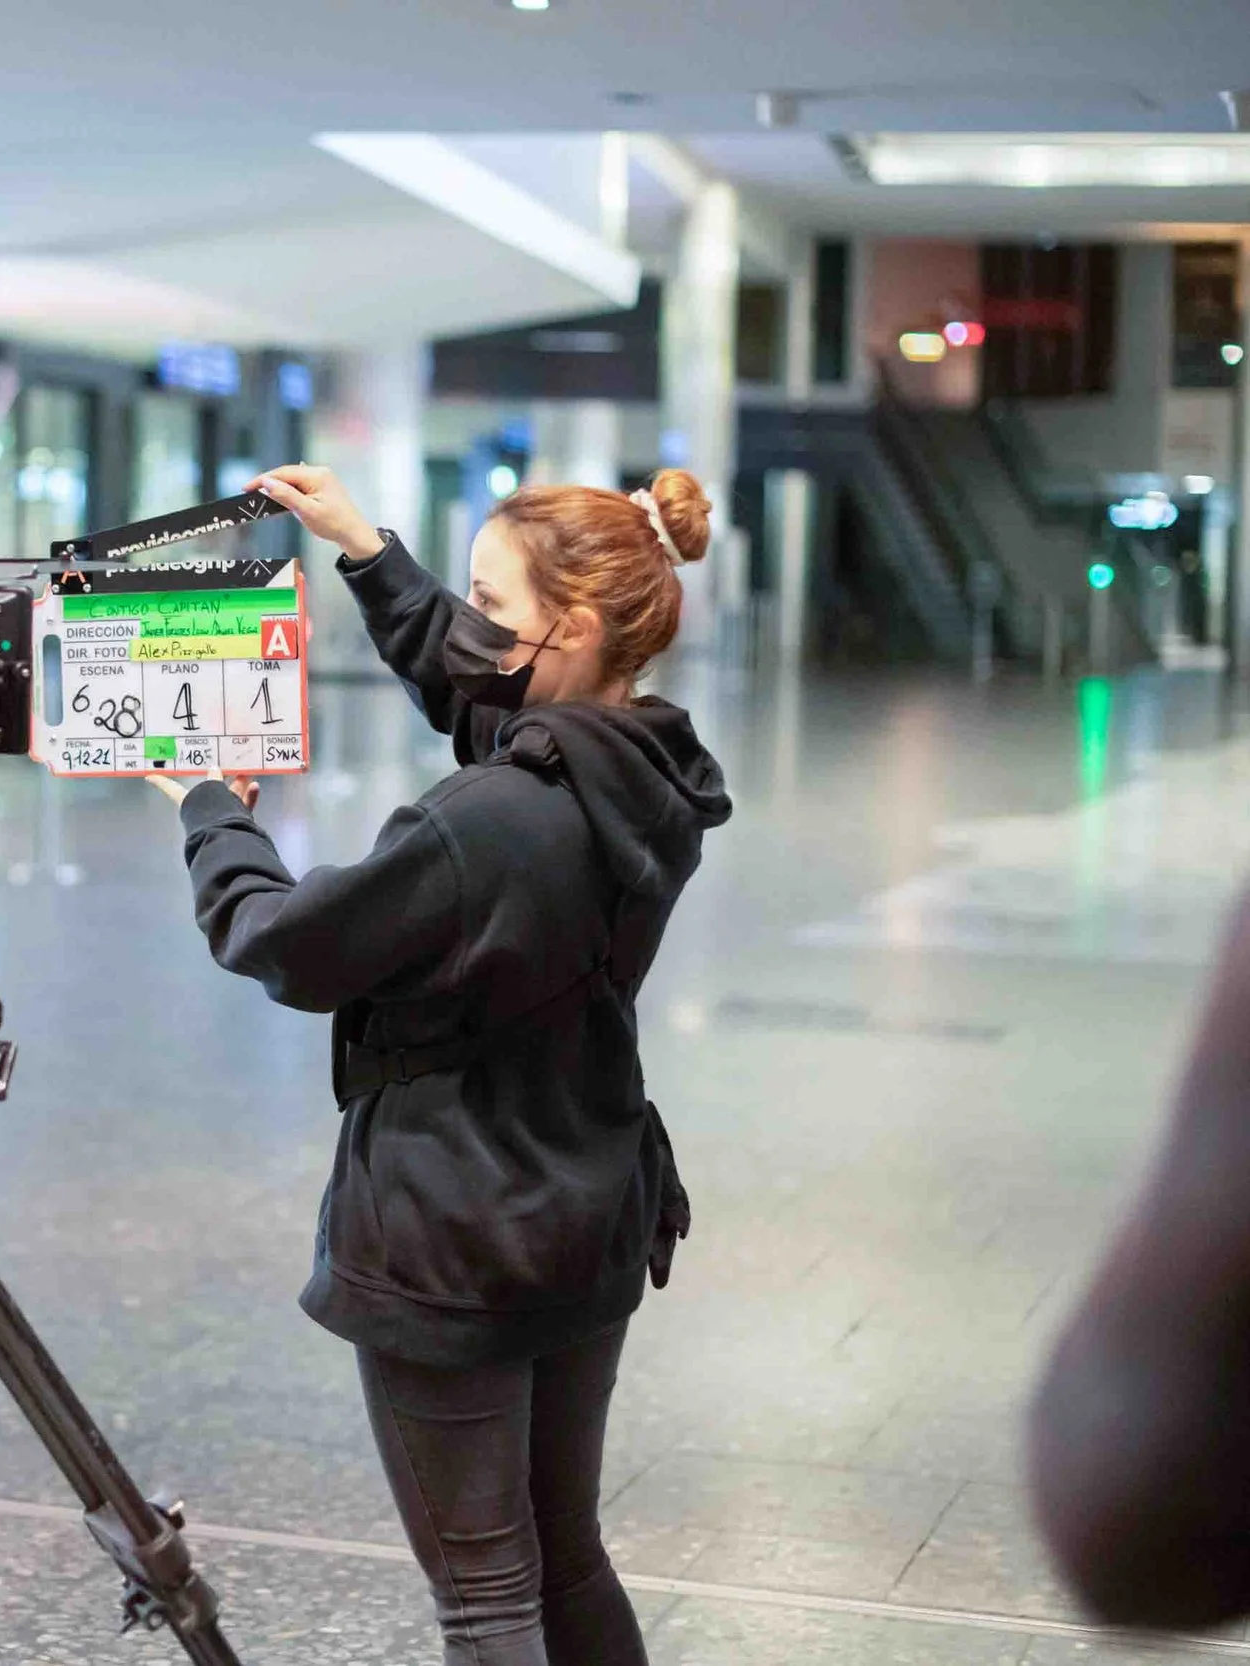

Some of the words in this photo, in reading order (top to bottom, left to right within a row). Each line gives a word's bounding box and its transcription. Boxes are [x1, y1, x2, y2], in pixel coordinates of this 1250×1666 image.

[265, 622, 291, 656] A
[94, 647, 127, 658] FOTO
[137, 642, 168, 659] Alex
[80, 665, 125, 676] ESCENA
[161, 663, 200, 674] PLANO
[247, 660, 281, 671] TOMA
[250, 677, 284, 725] 1
[231, 737, 250, 745] CLIP
[265, 745, 300, 762] SYNK
